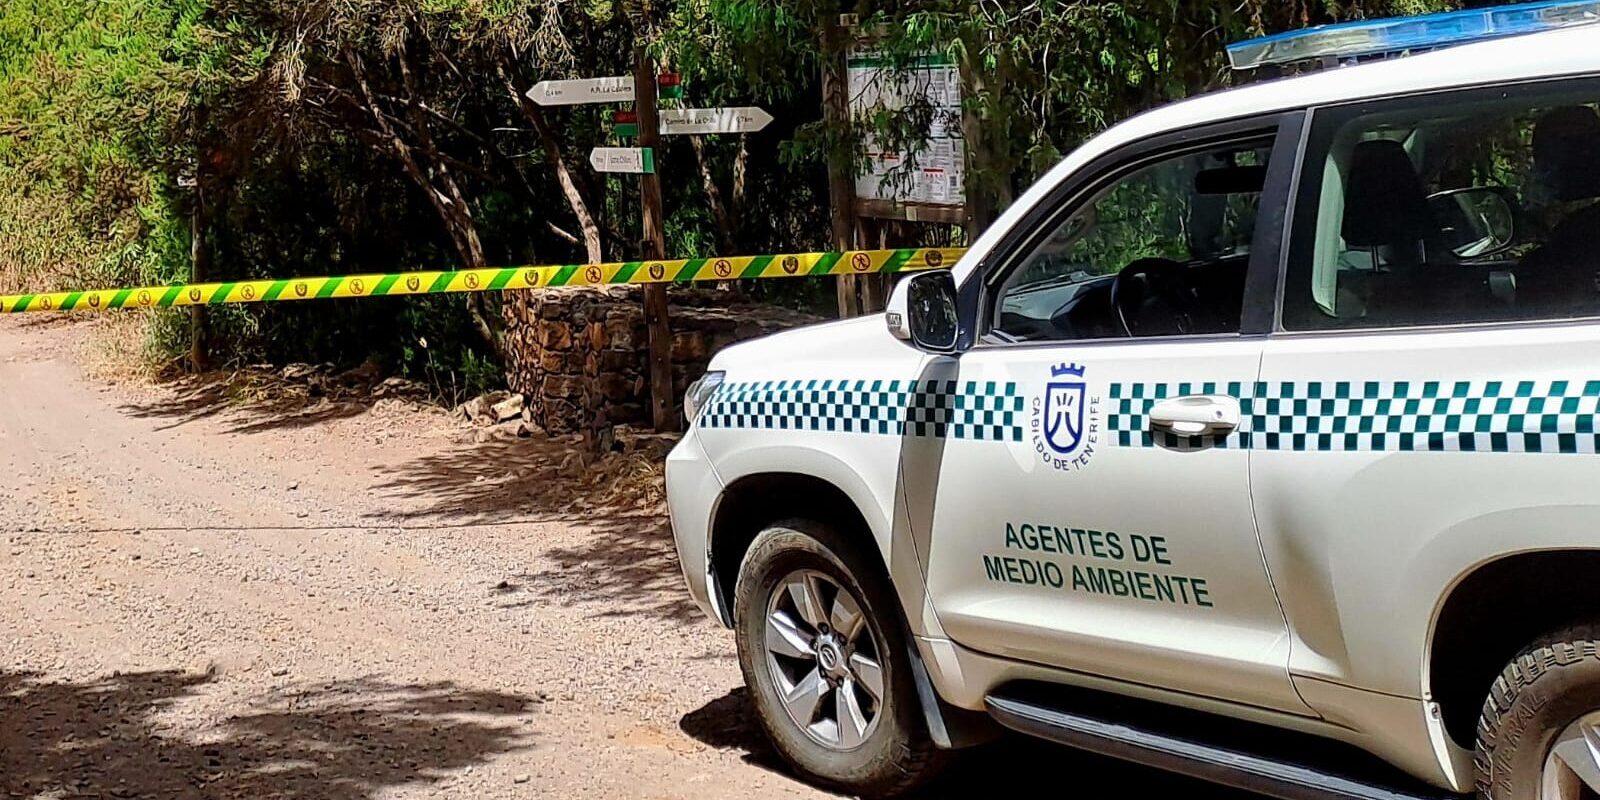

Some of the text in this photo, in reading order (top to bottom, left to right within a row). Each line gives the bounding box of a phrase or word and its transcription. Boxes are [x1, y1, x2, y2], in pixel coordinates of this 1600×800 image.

[1031, 395, 1101, 471] CABILDO DE TENERIFE
[1005, 522, 1172, 565] AGENTES DE
[983, 555, 1213, 607] MEDIO AMBIENTE
